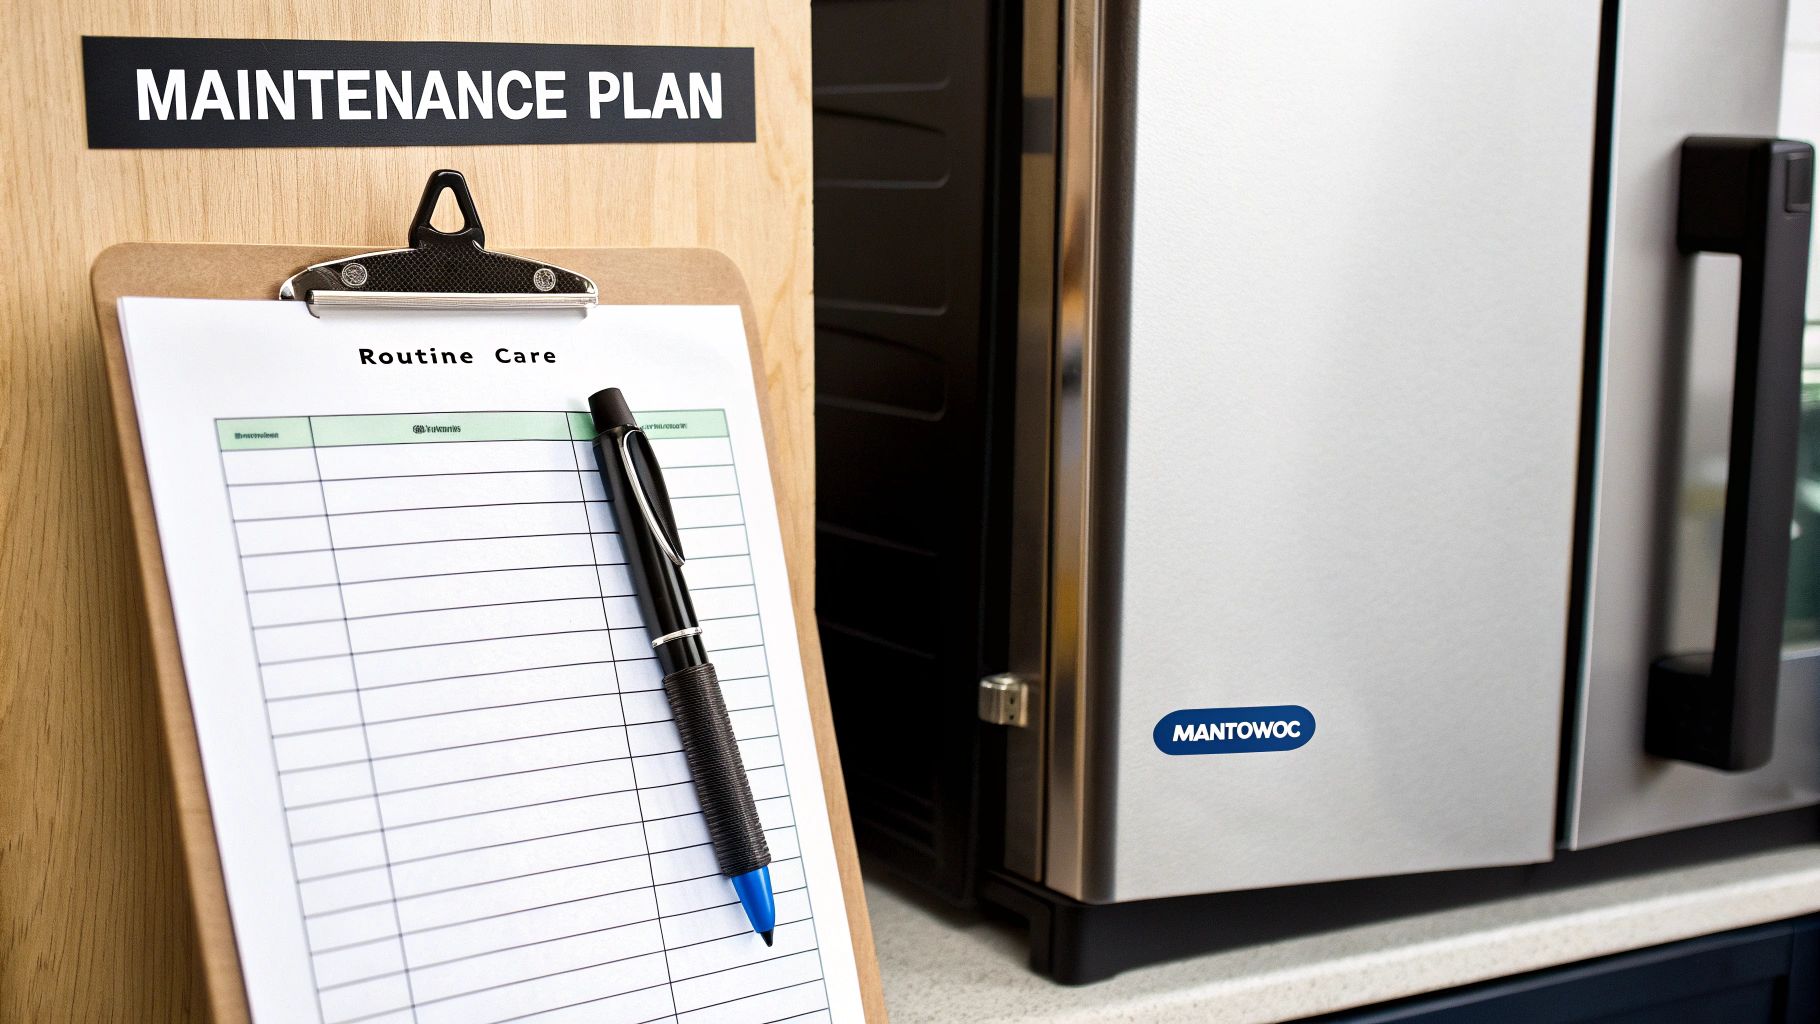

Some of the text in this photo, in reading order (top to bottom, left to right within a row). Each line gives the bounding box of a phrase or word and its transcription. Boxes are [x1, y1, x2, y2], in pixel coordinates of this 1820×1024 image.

[136, 68, 723, 121] MAINTENANCE PLAN
[358, 347, 557, 365] Routine Care
[1172, 720, 1301, 742] MANTOWOC
